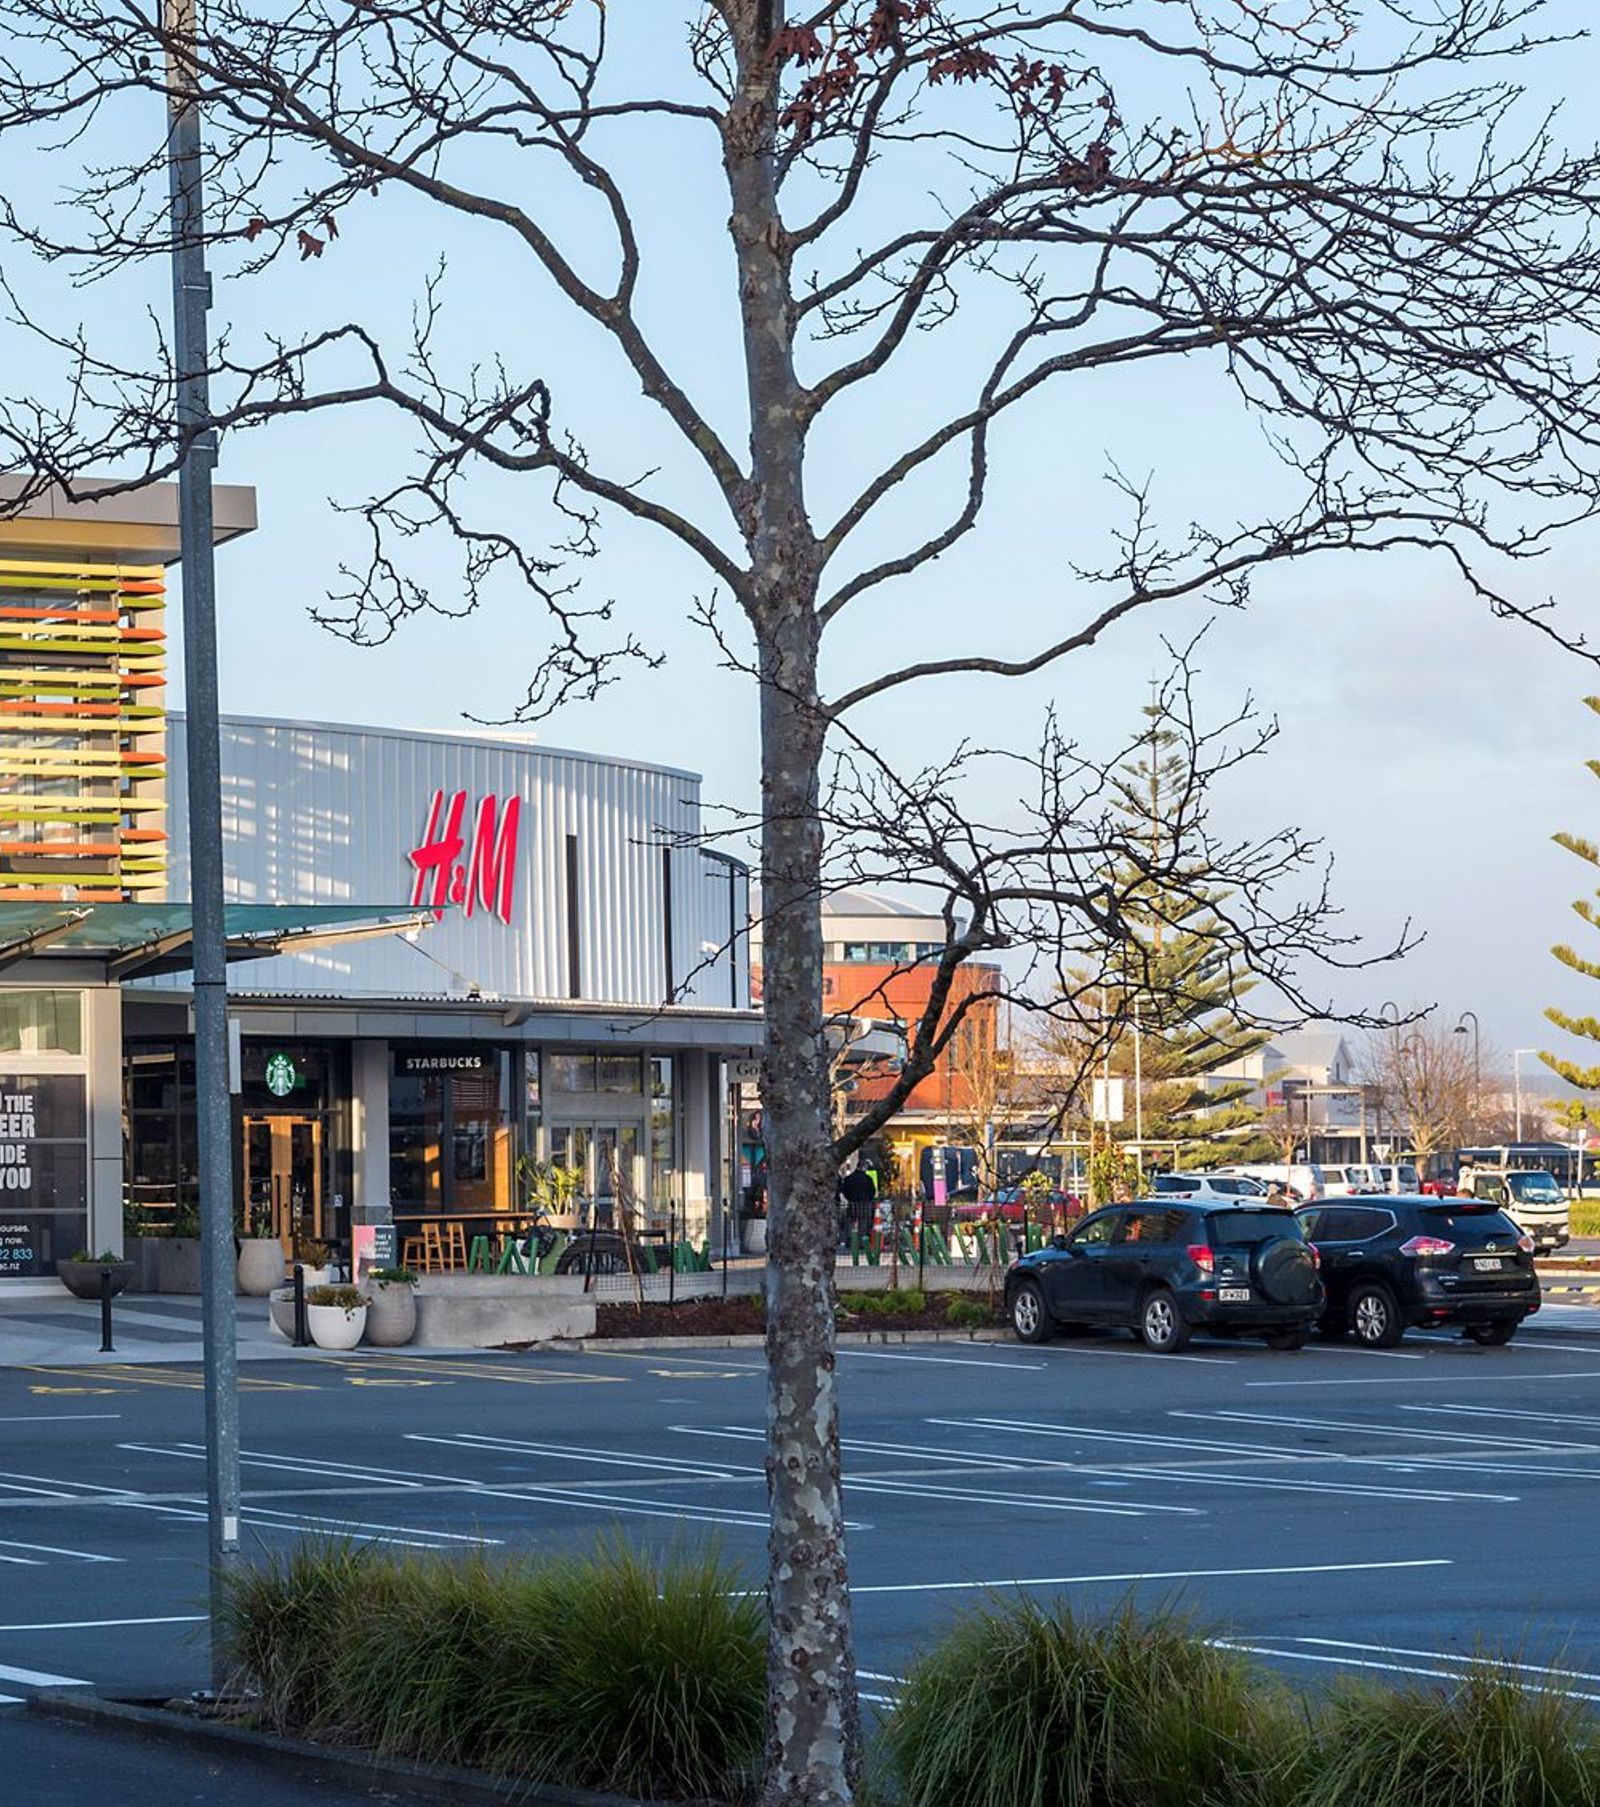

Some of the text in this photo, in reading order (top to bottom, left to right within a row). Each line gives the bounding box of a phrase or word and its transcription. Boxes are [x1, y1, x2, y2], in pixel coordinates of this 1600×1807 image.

[408, 789, 521, 925] H&M
[406, 1057, 482, 1070] STARBUCKS
[4, 1094, 33, 1113] THE
